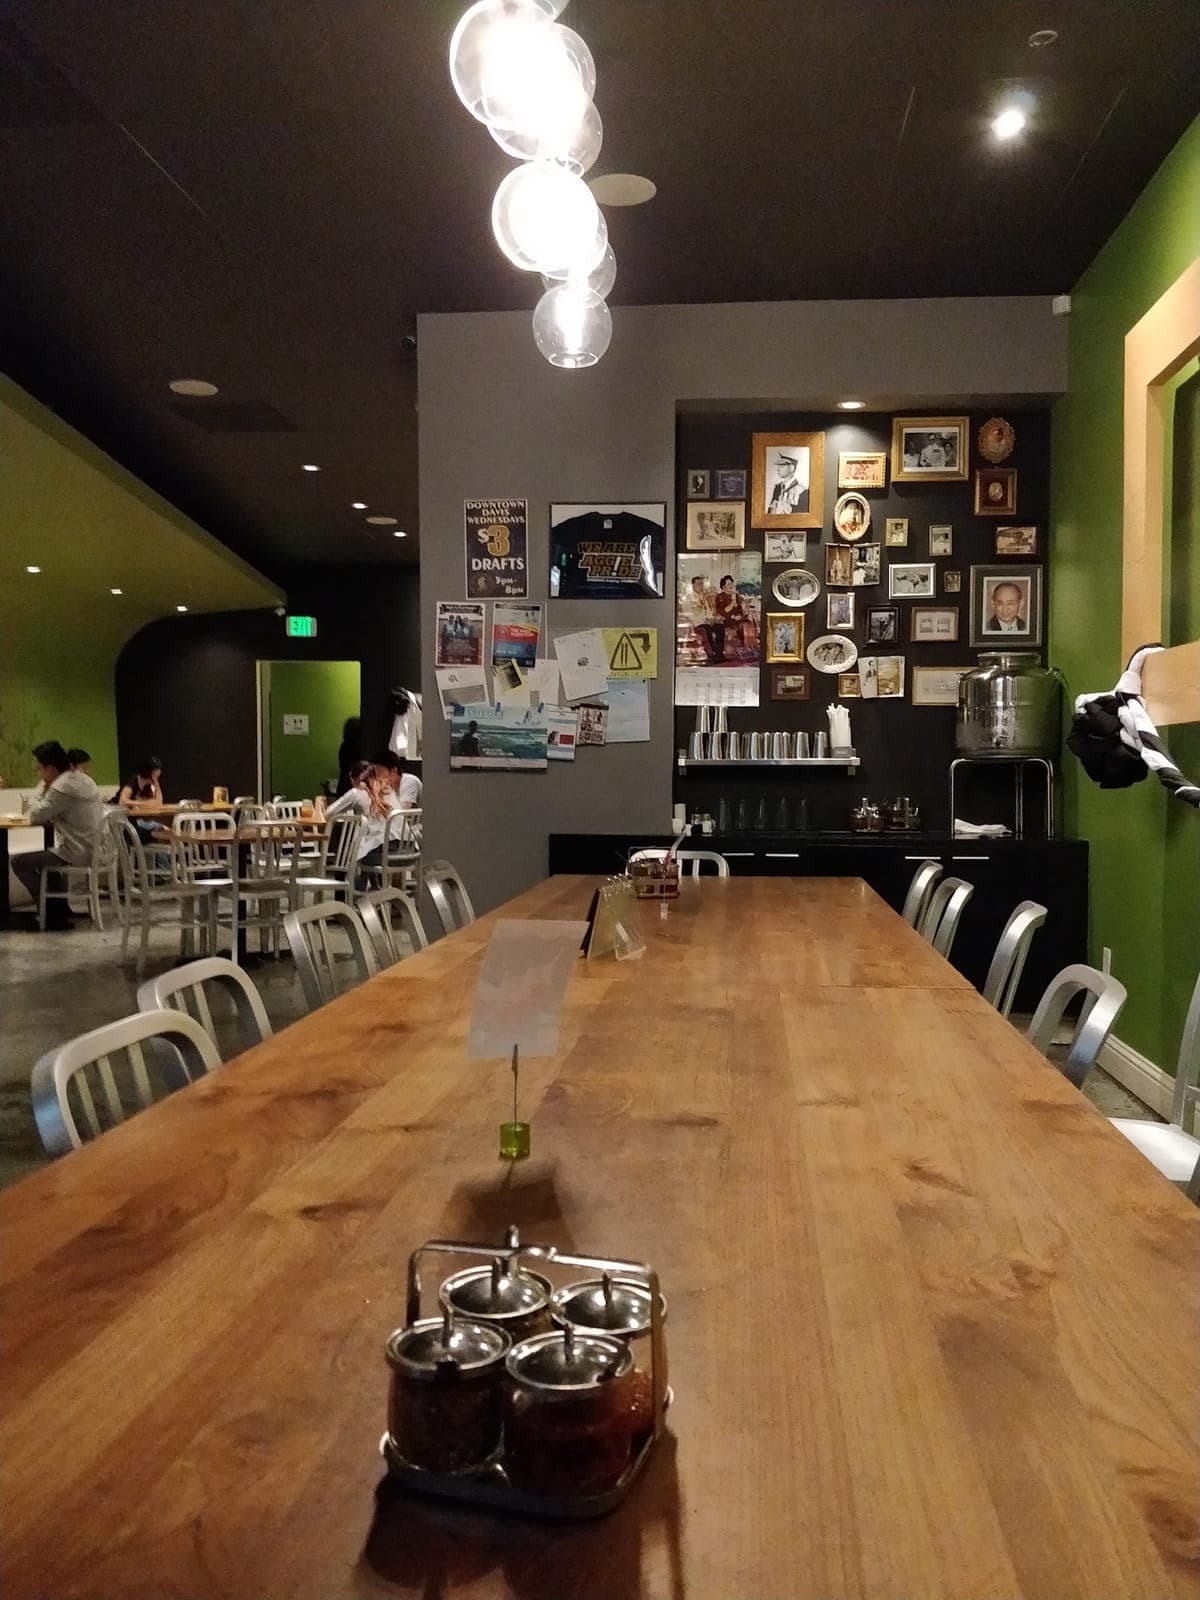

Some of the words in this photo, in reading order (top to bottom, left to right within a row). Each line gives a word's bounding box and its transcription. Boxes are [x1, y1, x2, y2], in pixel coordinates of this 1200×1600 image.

[466, 501, 525, 510] DOWNTOWN
[481, 508, 510, 517] DAVIS
[466, 516, 525, 525] WEDNESDAYS
[471, 557, 525, 571] DRAFTS
